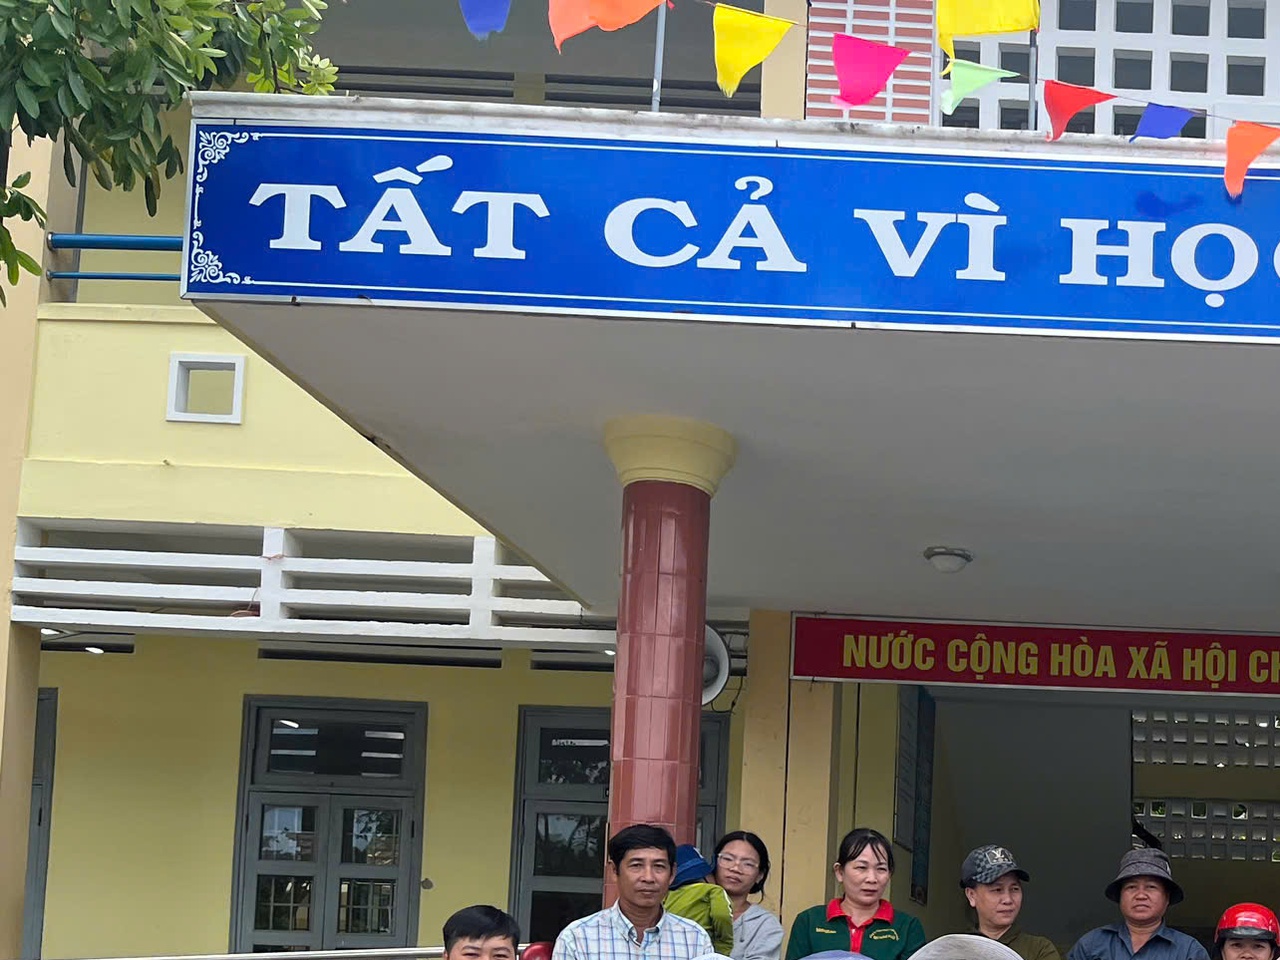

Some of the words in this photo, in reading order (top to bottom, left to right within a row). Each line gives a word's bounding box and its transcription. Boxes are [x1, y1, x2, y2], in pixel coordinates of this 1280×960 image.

[249, 155, 550, 259] TẤT
[605, 176, 806, 272] CẢ
[854, 193, 1006, 280] VÌ
[844, 630, 935, 670] NƯỚC
[948, 633, 1038, 680] CỘNG
[1051, 637, 1116, 677] HÒA
[1128, 640, 1171, 680] XÃ
[1183, 643, 1237, 689] HỘI
